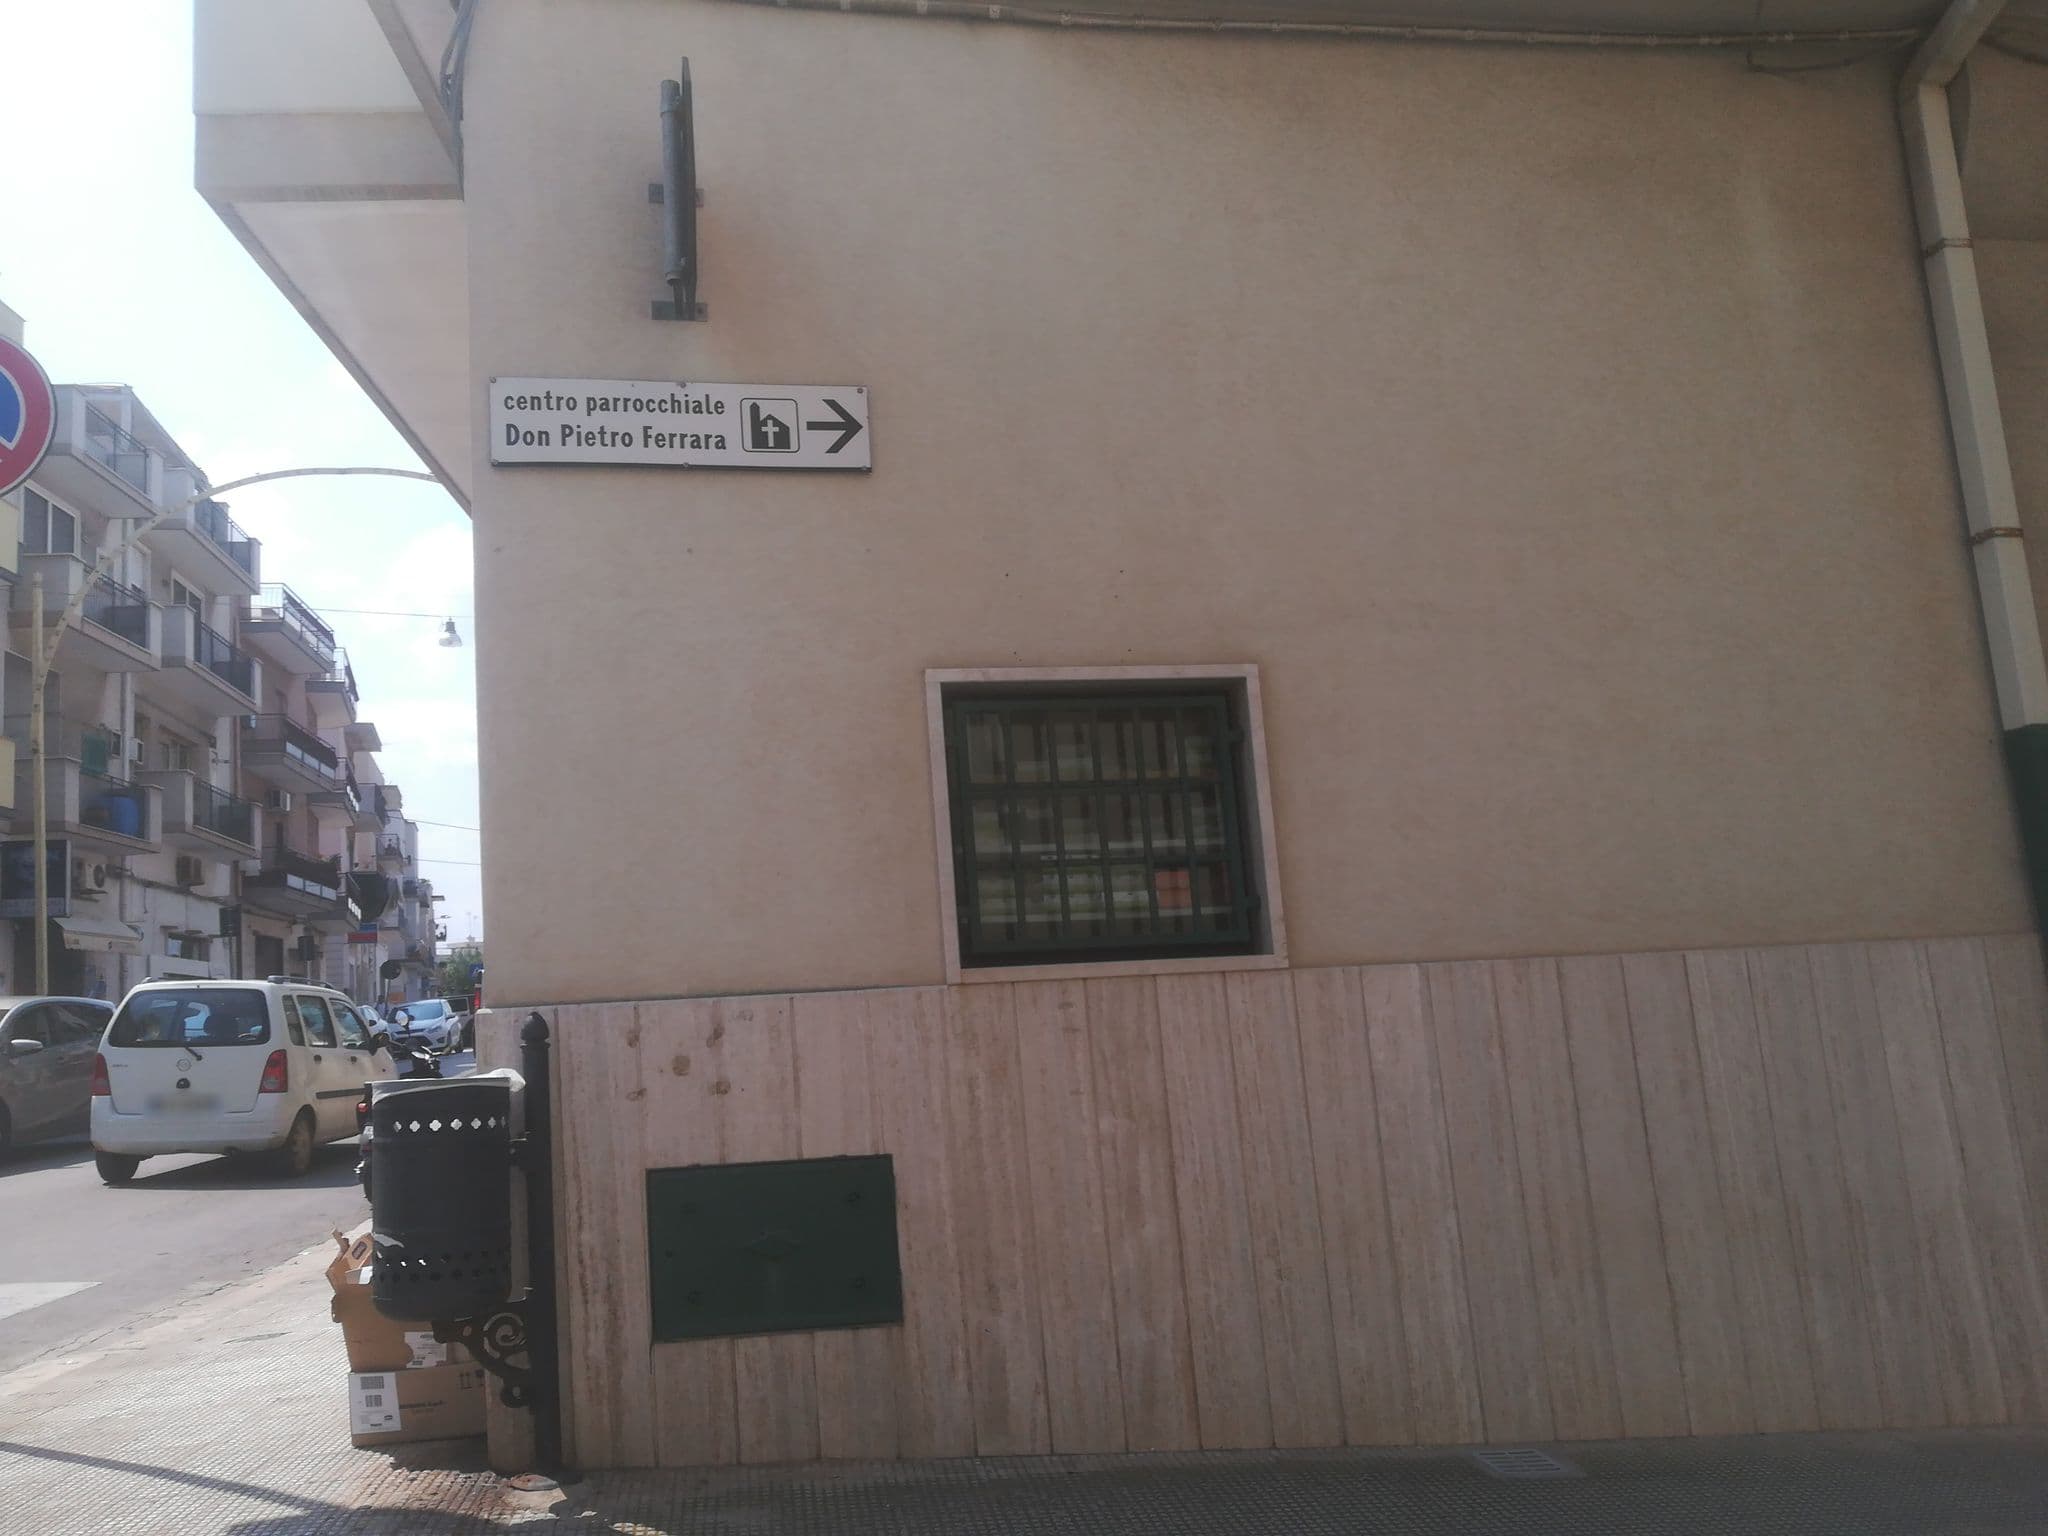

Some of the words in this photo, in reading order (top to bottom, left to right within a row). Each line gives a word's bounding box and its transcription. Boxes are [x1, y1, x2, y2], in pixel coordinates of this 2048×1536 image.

[503, 391, 577, 411] centro
[586, 393, 725, 417] parrocchiale
[505, 423, 550, 447] Don
[560, 424, 634, 448] Pietro
[642, 426, 727, 451] Ferrara
